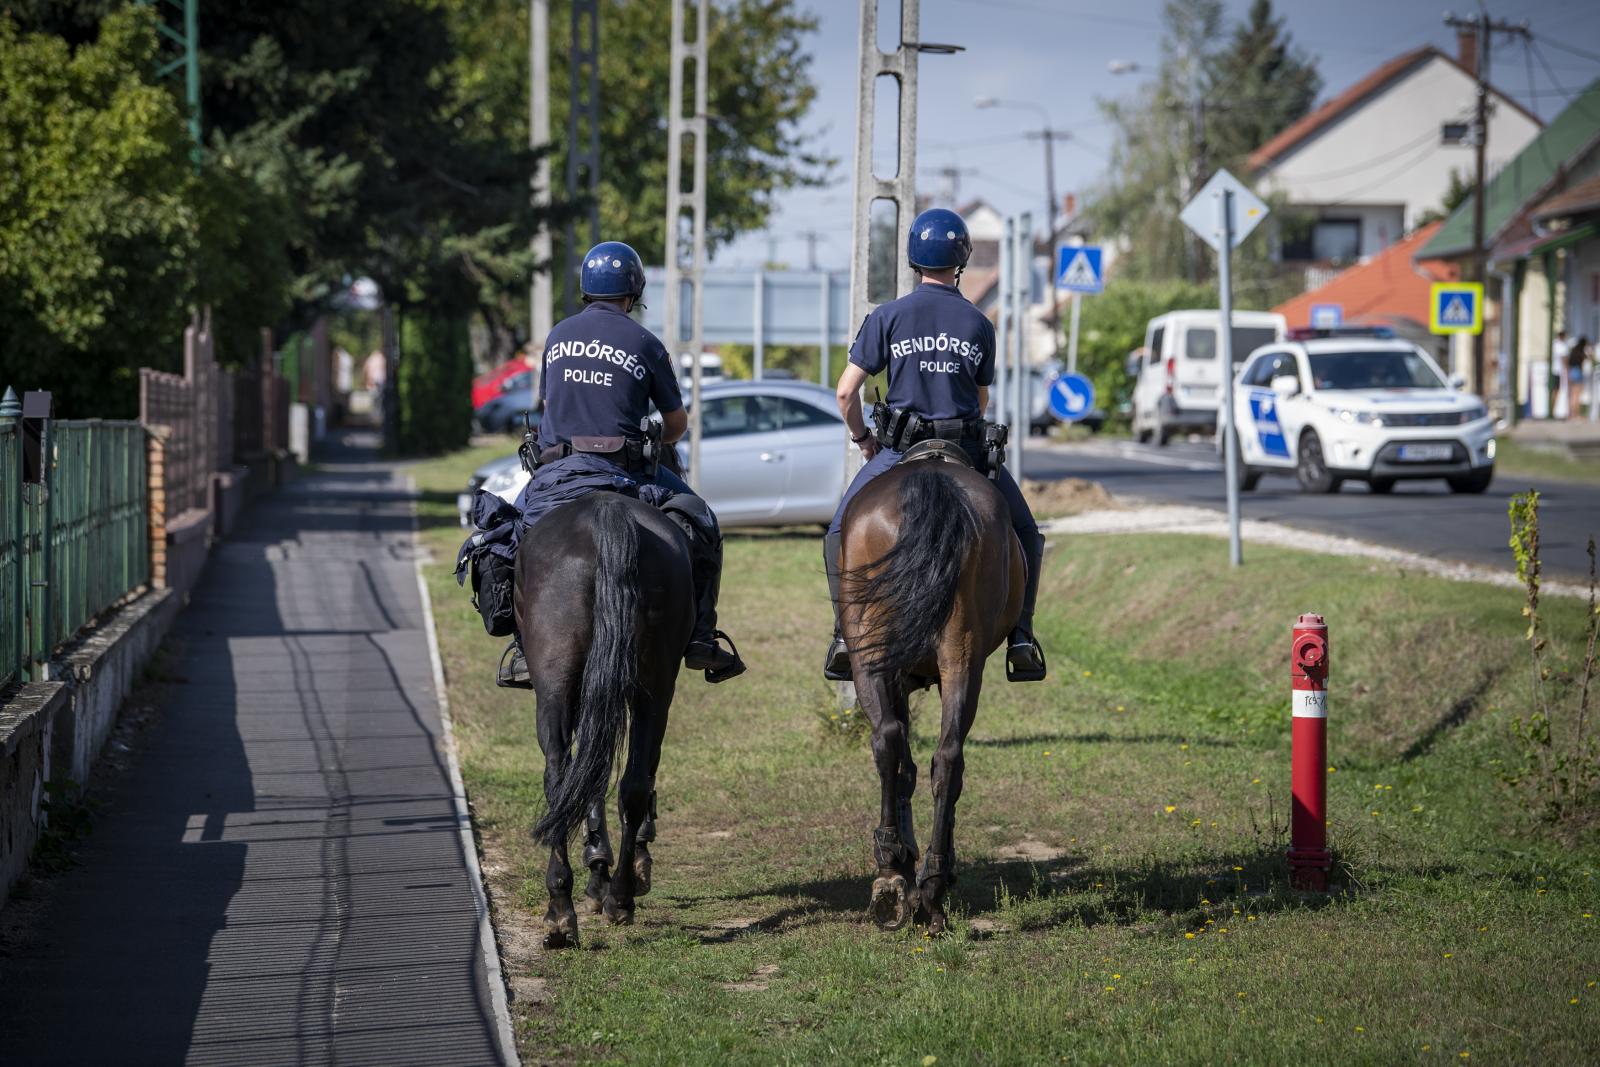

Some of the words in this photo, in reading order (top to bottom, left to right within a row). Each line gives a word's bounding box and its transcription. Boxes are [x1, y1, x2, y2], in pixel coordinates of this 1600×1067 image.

[546, 339, 646, 381] RENDŐRSÉG
[890, 332, 983, 366] RENDŐRSÉG
[564, 368, 613, 387] POLICE
[919, 360, 961, 374] POLICE
